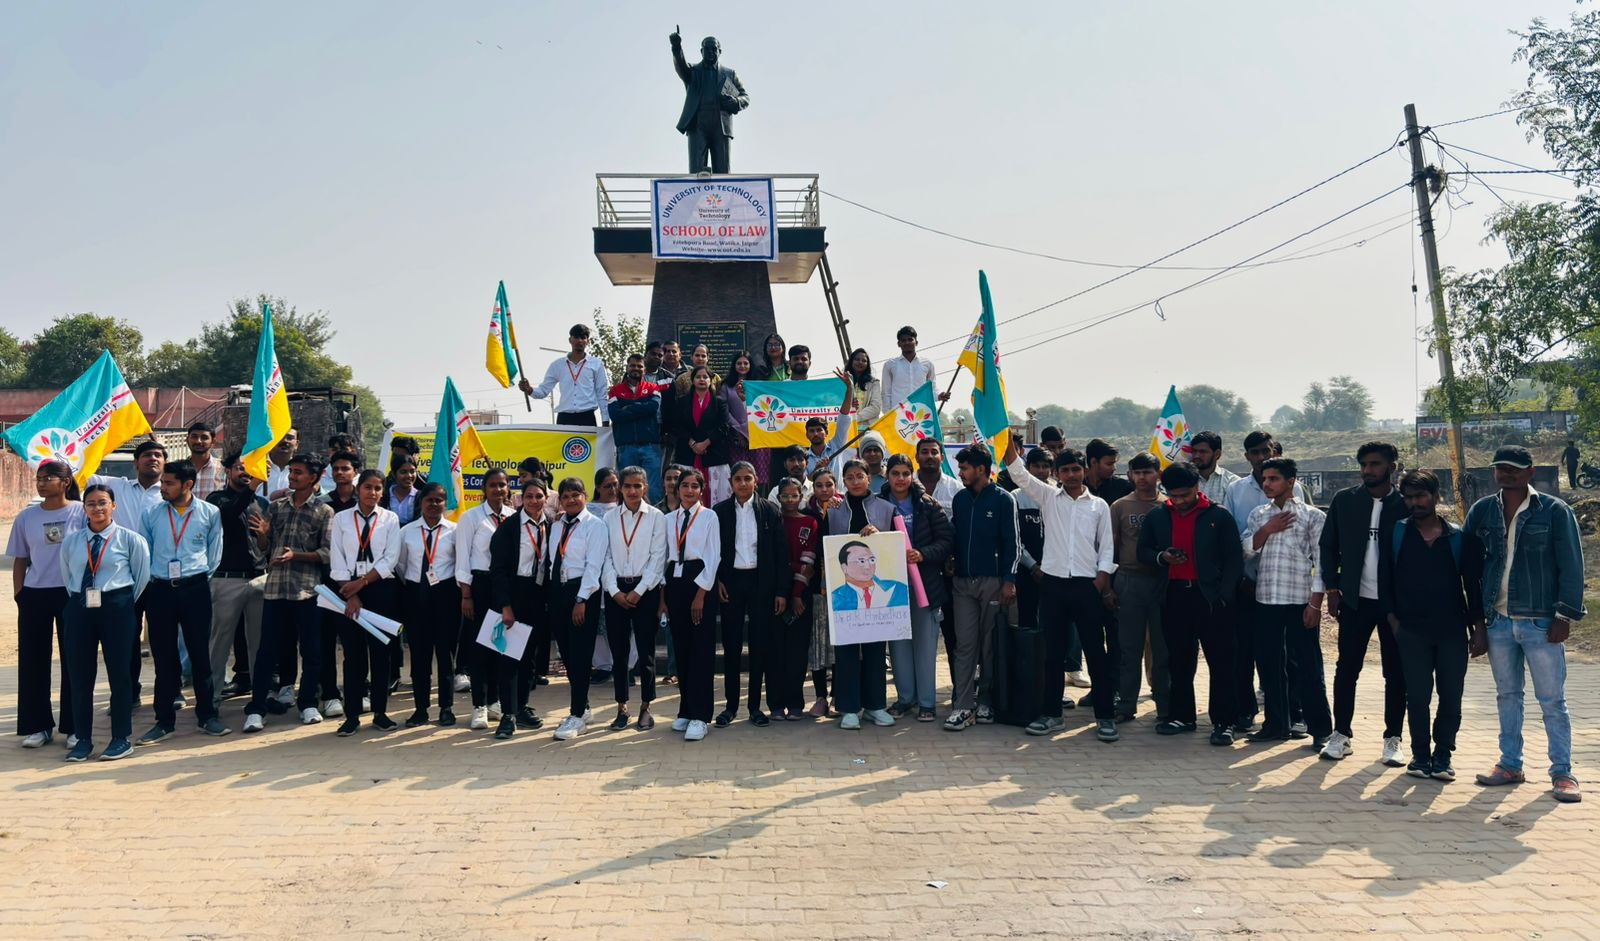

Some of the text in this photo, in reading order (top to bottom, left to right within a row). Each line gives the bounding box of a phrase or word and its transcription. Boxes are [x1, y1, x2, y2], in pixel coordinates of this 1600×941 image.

[662, 185, 701, 218] UNIVERSITY
[717, 185, 767, 217] TECHNOLOGY
[662, 225, 767, 237] SCHOOL OF LAW
